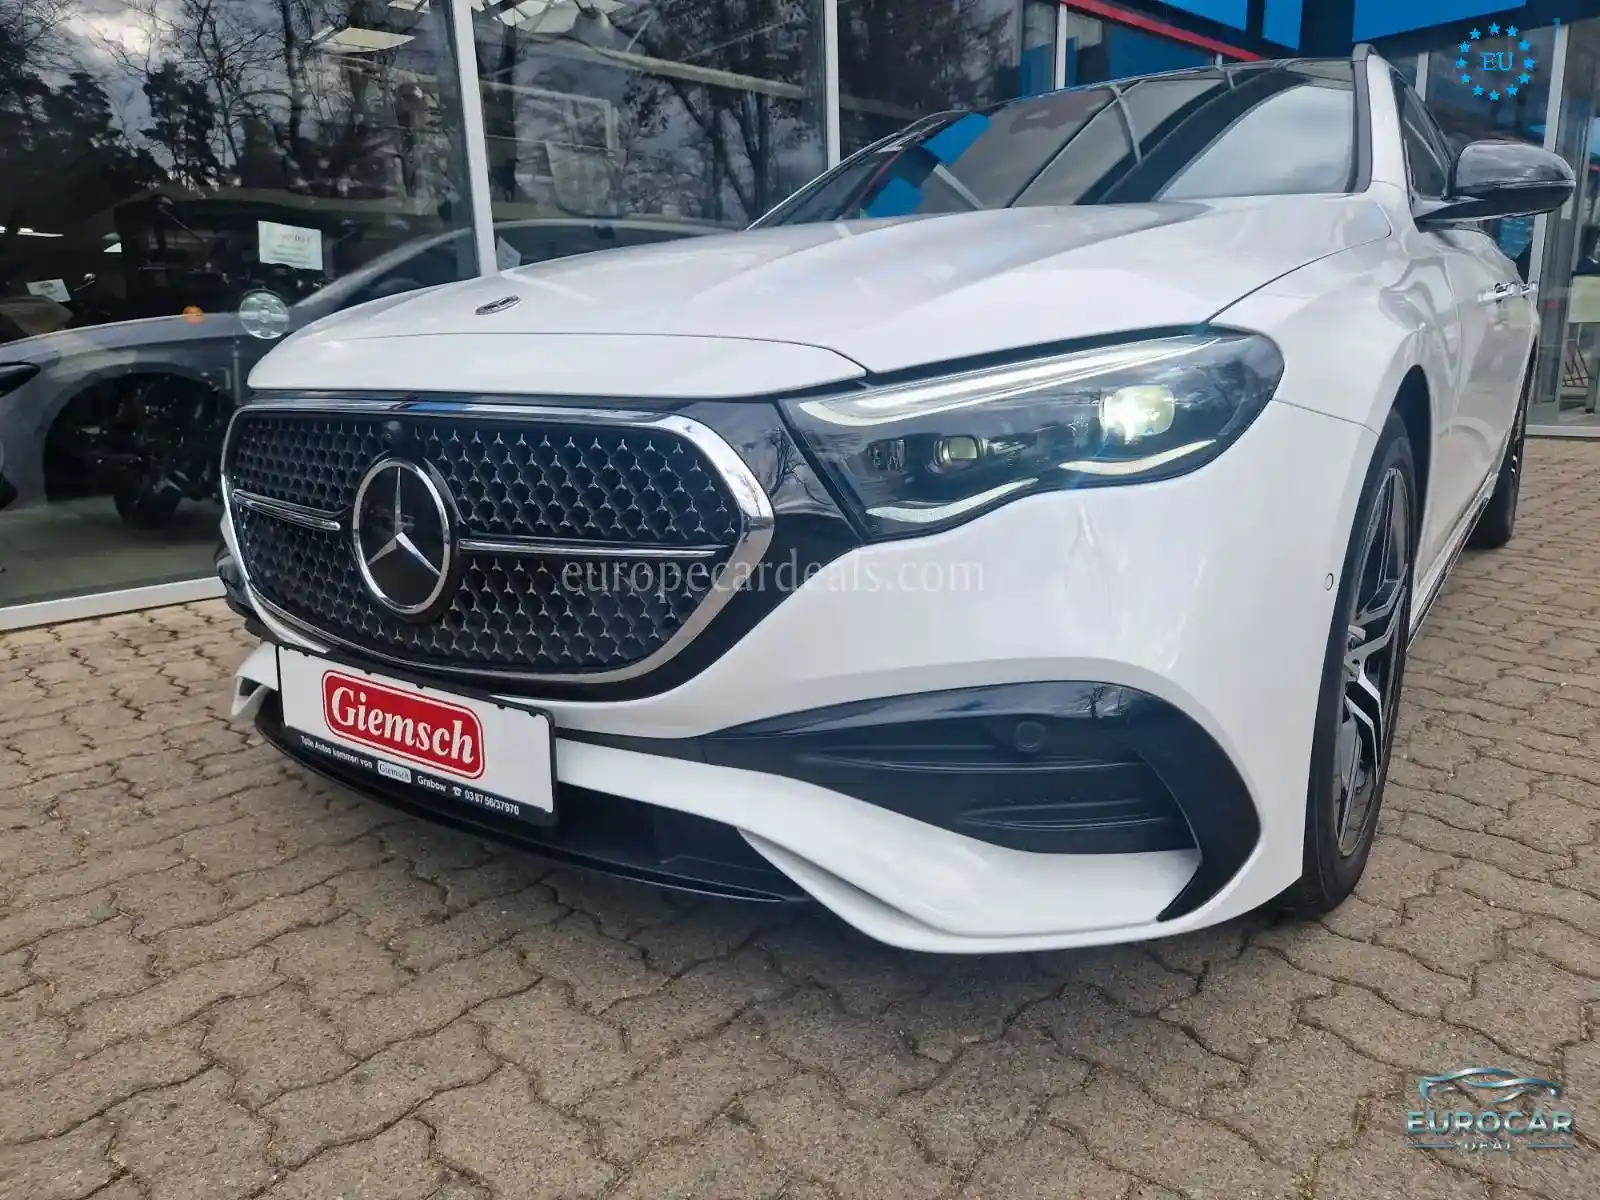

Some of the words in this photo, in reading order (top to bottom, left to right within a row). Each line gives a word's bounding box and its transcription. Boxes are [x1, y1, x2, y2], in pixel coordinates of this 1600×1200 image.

[331, 685, 475, 765] Giemsch
[360, 759, 373, 769] von
[417, 775, 447, 792] Grabow
